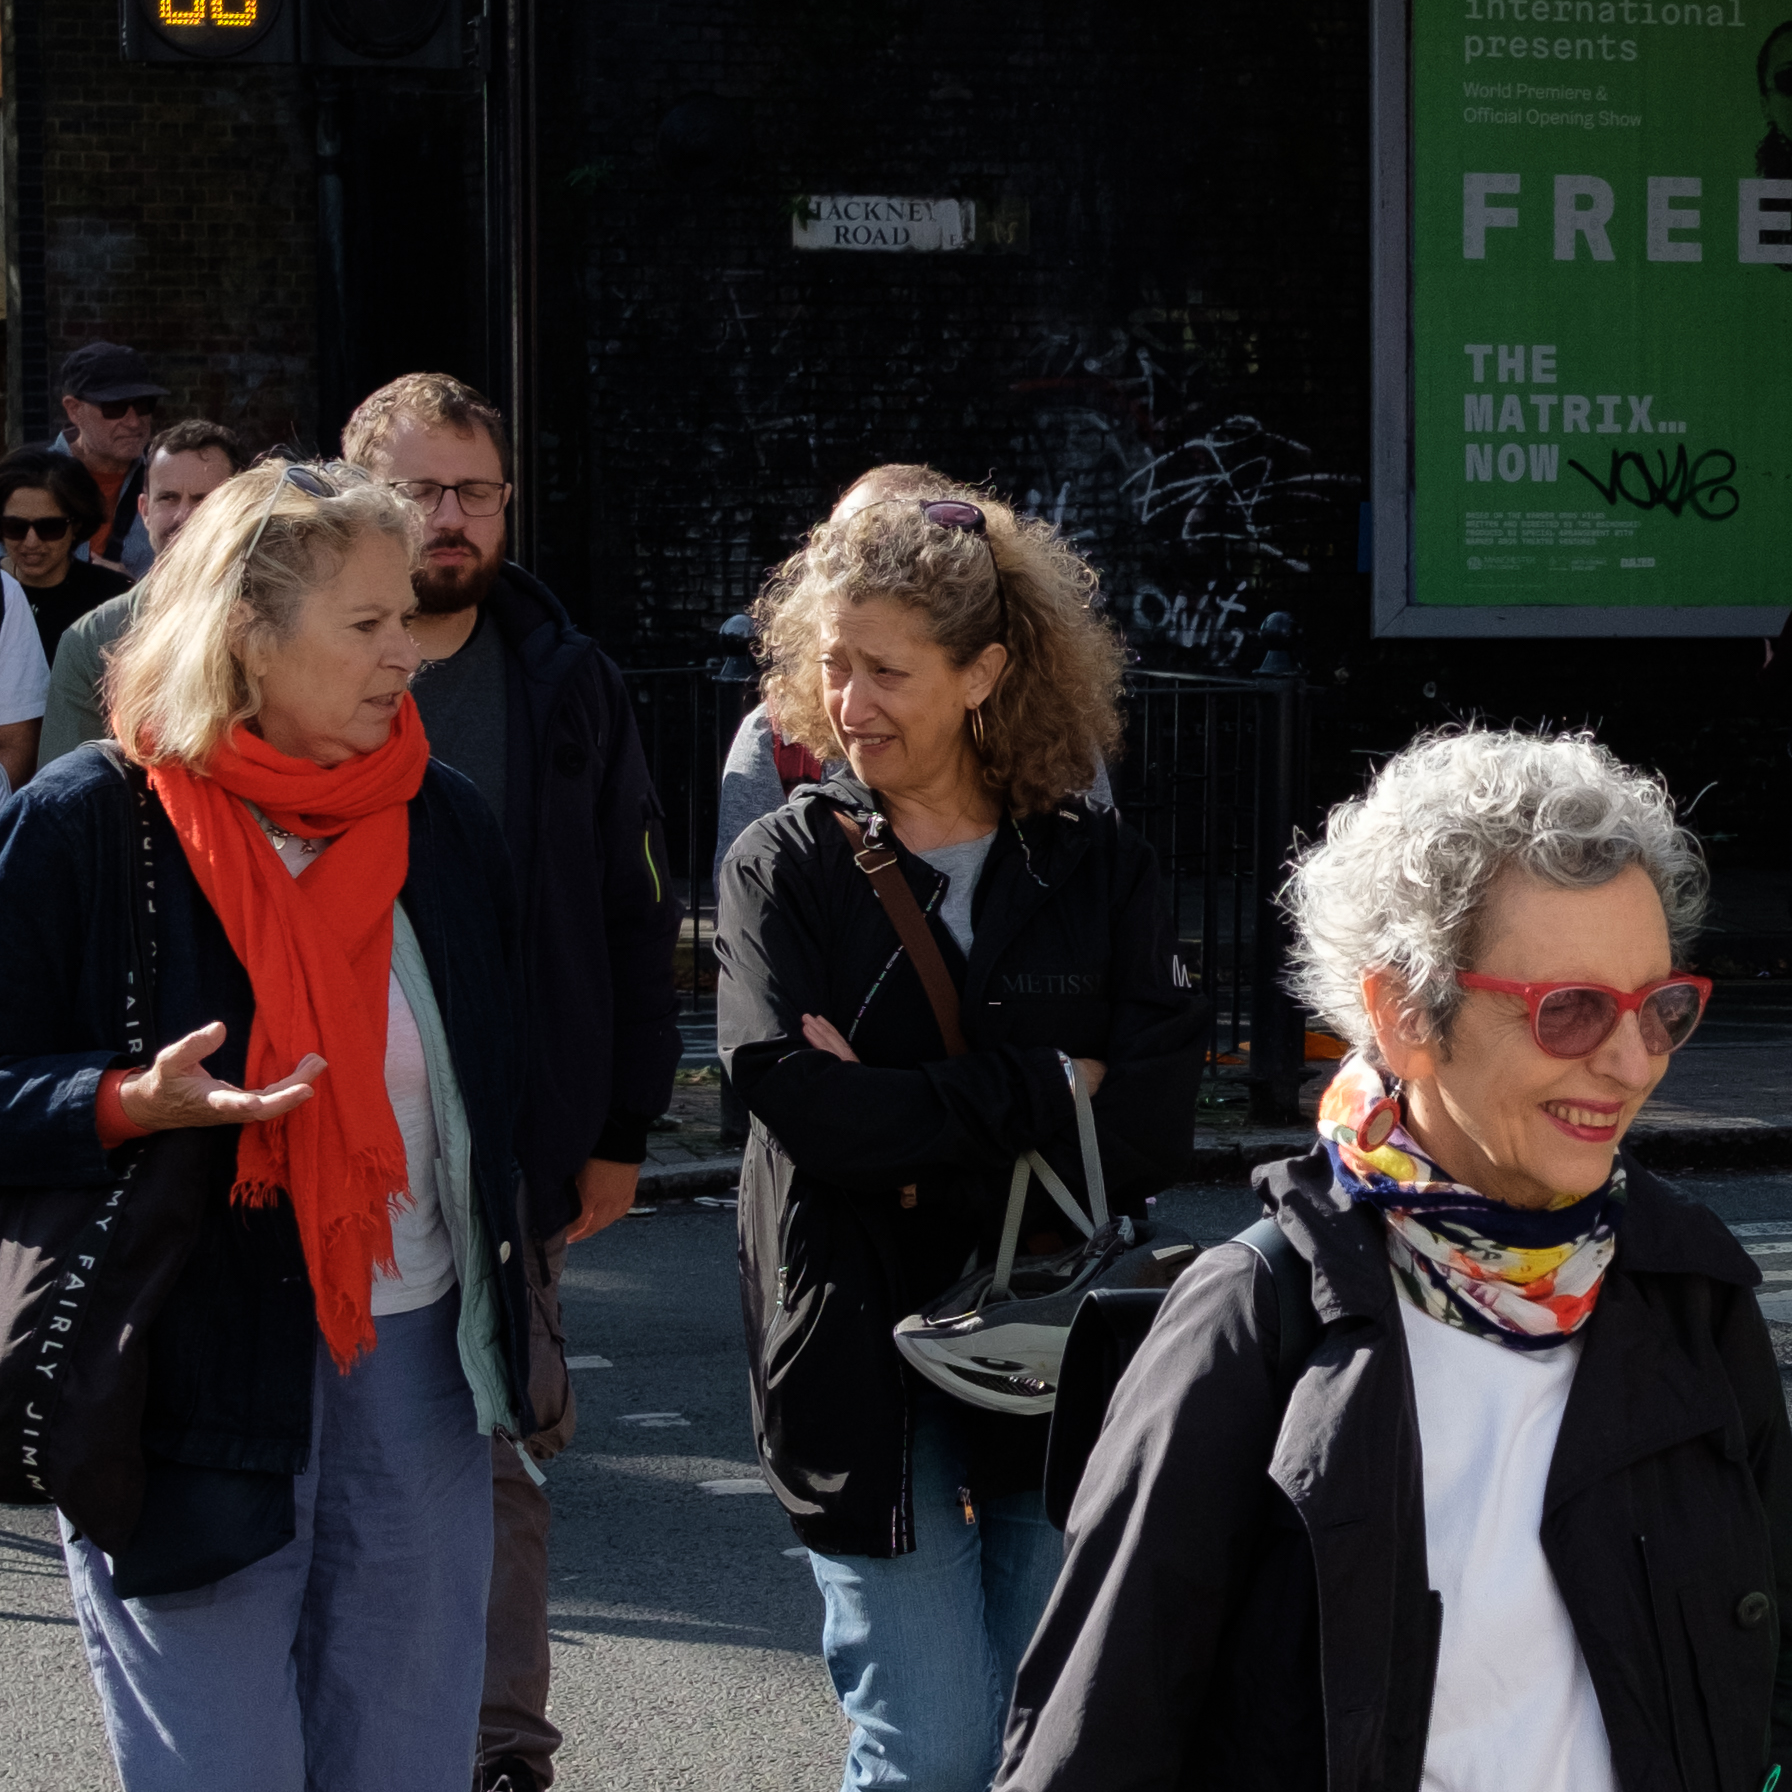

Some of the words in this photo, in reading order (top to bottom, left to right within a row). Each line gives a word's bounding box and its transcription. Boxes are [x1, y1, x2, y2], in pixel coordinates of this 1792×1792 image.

[1464, 33, 1639, 64] presents
[1463, 81, 1512, 100] World
[1515, 83, 1592, 102] Premiere
[1596, 84, 1608, 102] &
[1463, 107, 1522, 125] Official
[1525, 108, 1595, 129] Opening
[1598, 110, 1643, 127] Show
[834, 225, 911, 246] ROAD
[1464, 343, 1558, 384] THE
[1465, 443, 1560, 483] NOW
[35, 1253, 96, 1381] FAIRLY
[21, 1400, 54, 1501] JIMM
